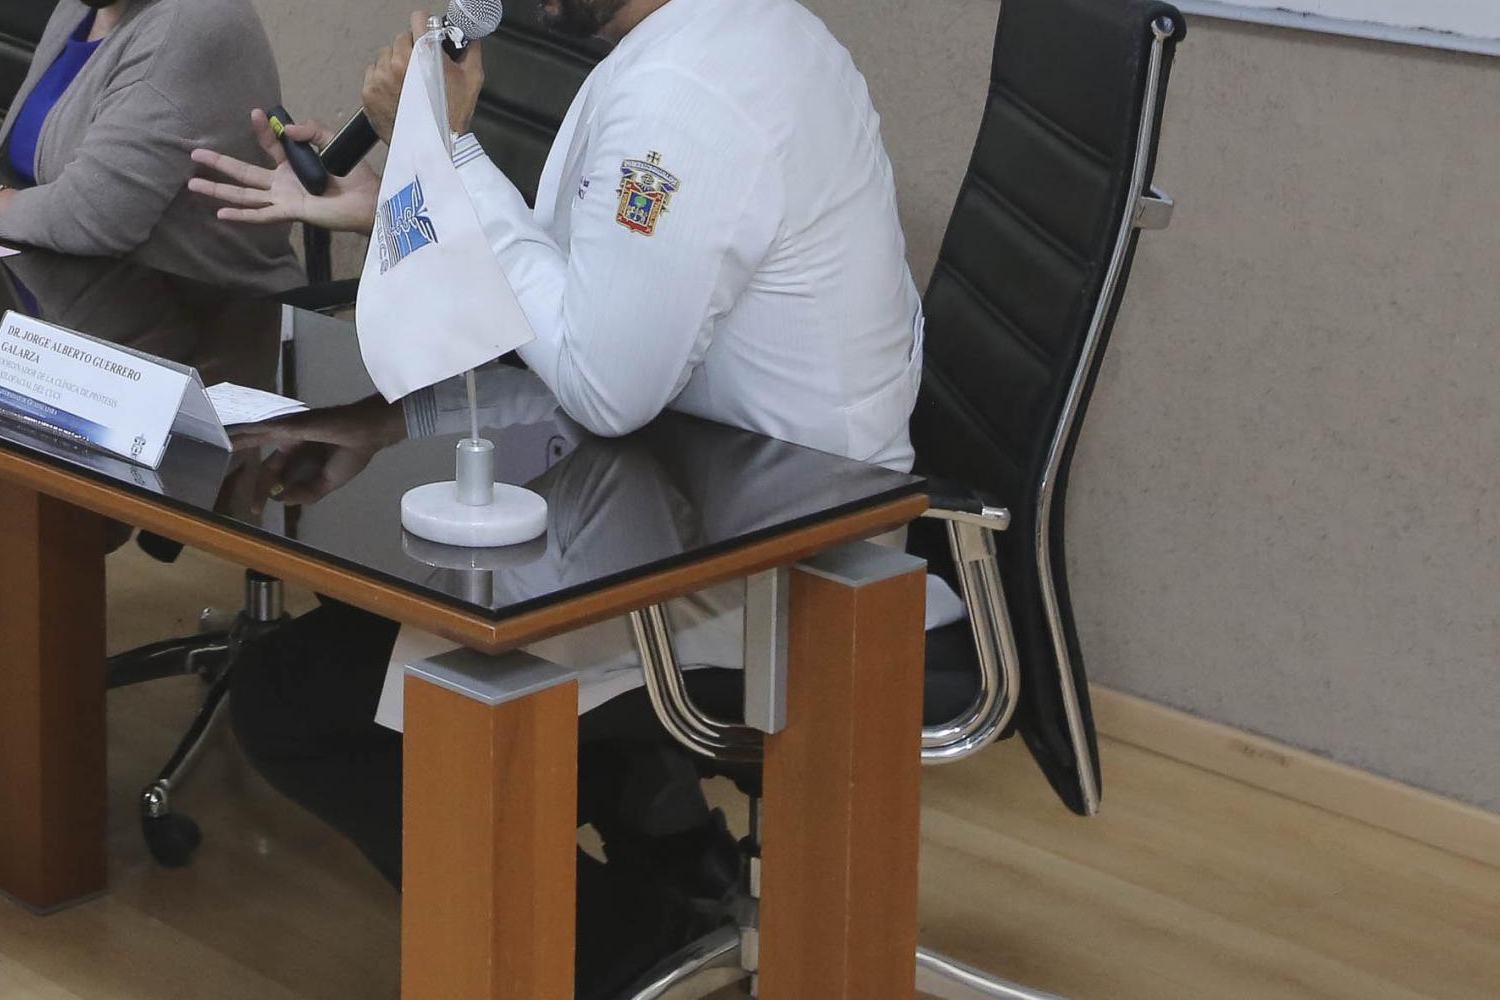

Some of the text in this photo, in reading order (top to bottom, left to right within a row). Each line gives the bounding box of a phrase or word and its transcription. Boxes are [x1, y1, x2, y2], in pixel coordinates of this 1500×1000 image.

[1, 341, 40, 364] GALARZA
[7, 325, 141, 382] DR. JORGE ALBERTO GUERRERO
